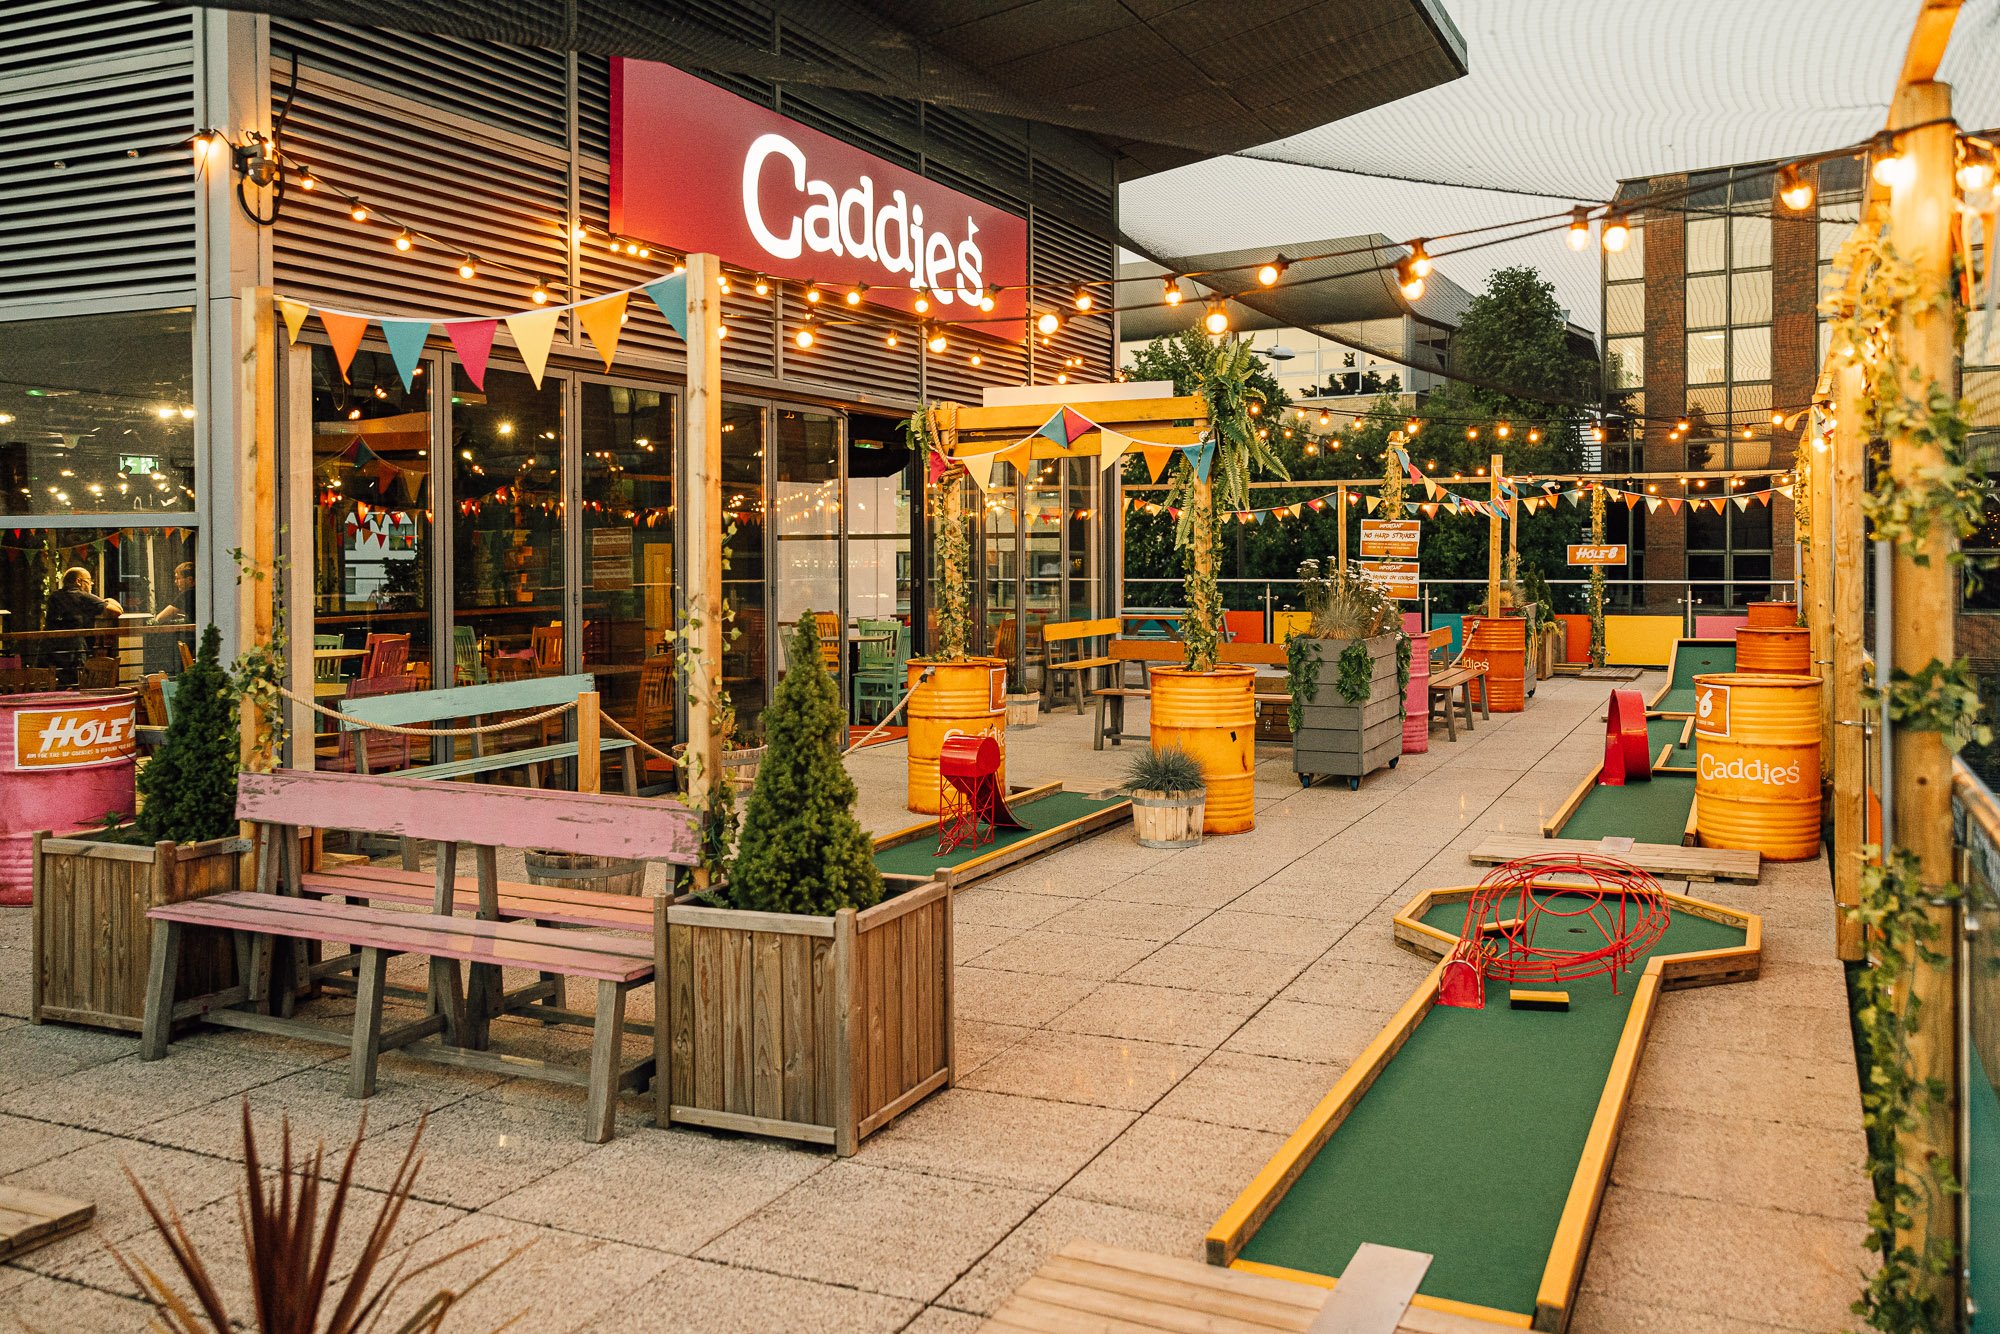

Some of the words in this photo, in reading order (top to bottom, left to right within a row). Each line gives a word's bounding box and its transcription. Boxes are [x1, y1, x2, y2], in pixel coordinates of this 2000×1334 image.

[743, 133, 984, 307] Caddies
[1576, 547, 1609, 560] HOLE
[1699, 689, 1713, 718] 6
[39, 715, 129, 753] HOLE
[1700, 753, 1800, 785] Caddies
